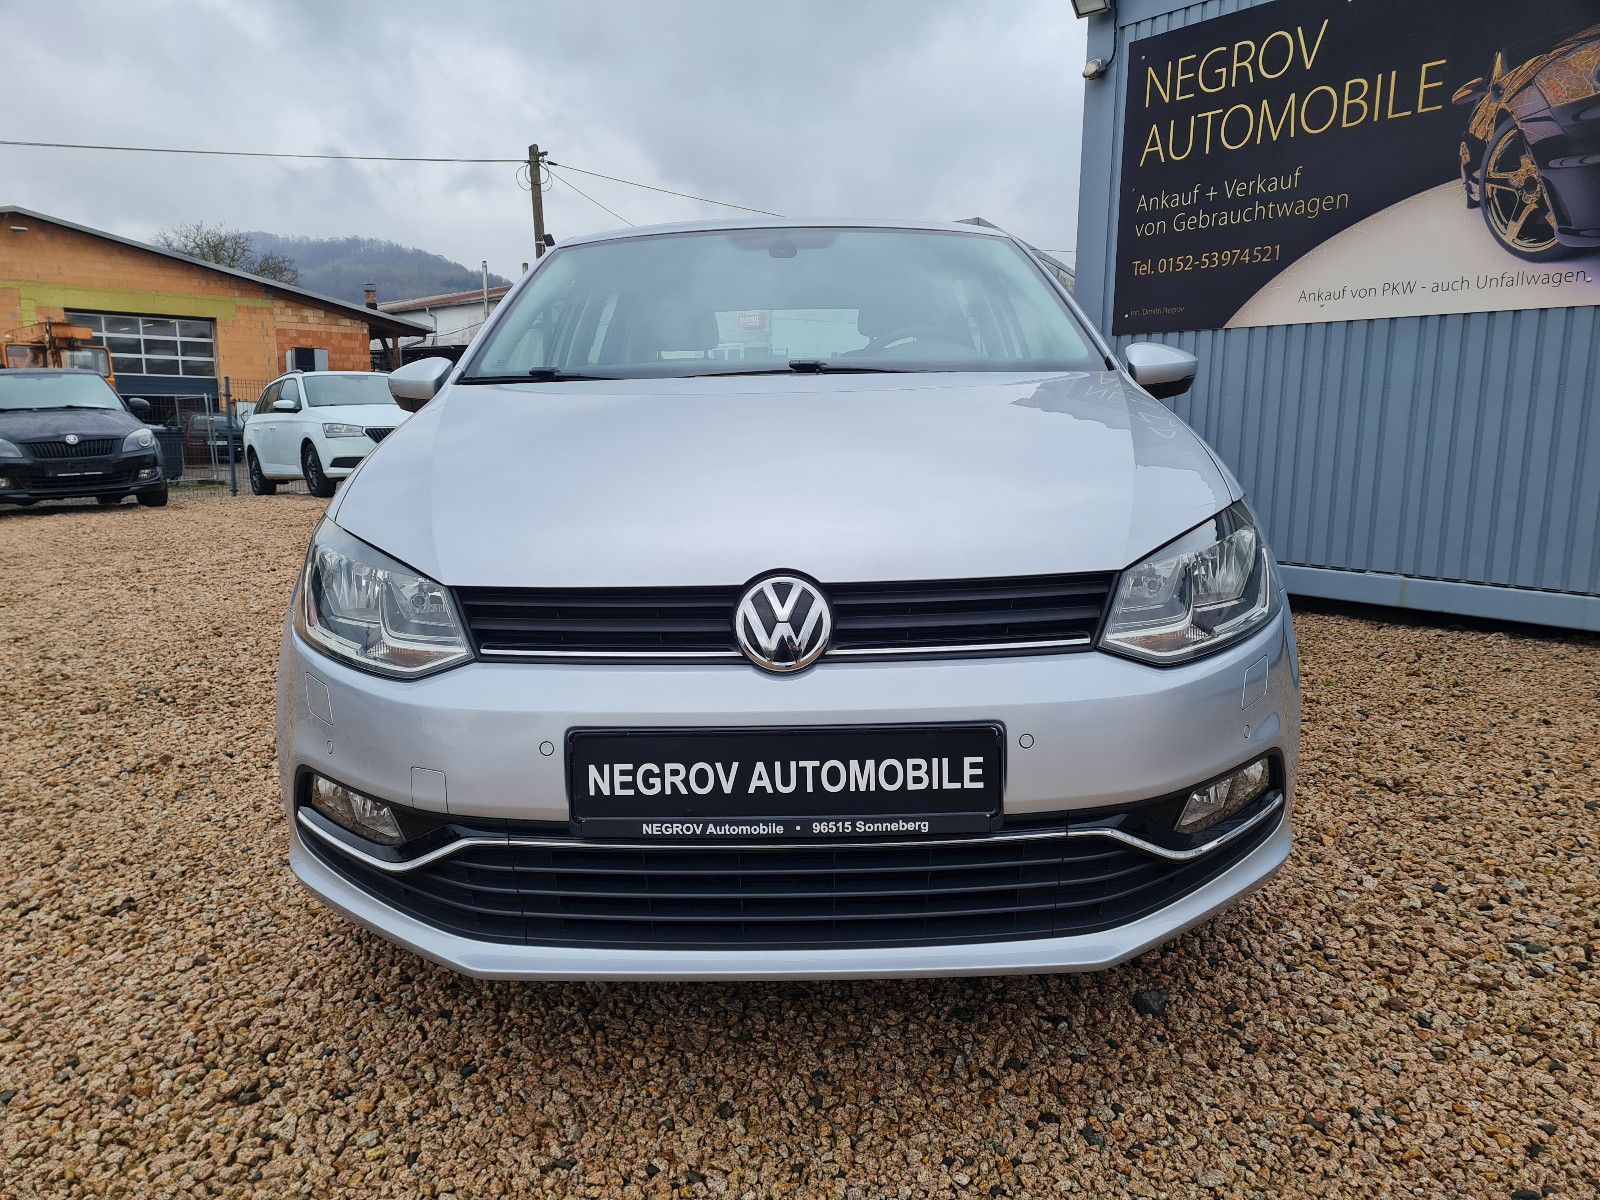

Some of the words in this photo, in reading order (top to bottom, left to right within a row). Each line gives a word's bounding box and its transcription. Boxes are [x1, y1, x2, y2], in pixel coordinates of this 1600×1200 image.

[1145, 19, 1329, 108] NEGROV
[1139, 59, 1447, 168] AUTOMOBILE
[1136, 183, 1202, 213] Ankauf
[1224, 166, 1303, 199] Verkauf
[1135, 219, 1167, 237] von
[1173, 192, 1350, 232] Gebrauchtwagen
[1132, 258, 1155, 276] Tel.
[1157, 244, 1281, 274] 0152-53974521
[1298, 285, 1348, 304] Ankauf
[1350, 286, 1377, 300] von
[1382, 280, 1418, 296] PKW
[1431, 275, 1470, 293] auch
[588, 761, 739, 796] NEGROV
[747, 756, 985, 794] AUTOMOBILE
[642, 822, 703, 835] NEGROV
[706, 821, 784, 835] Automobile
[812, 821, 852, 834] 96515
[855, 819, 929, 834] Sonneberg
